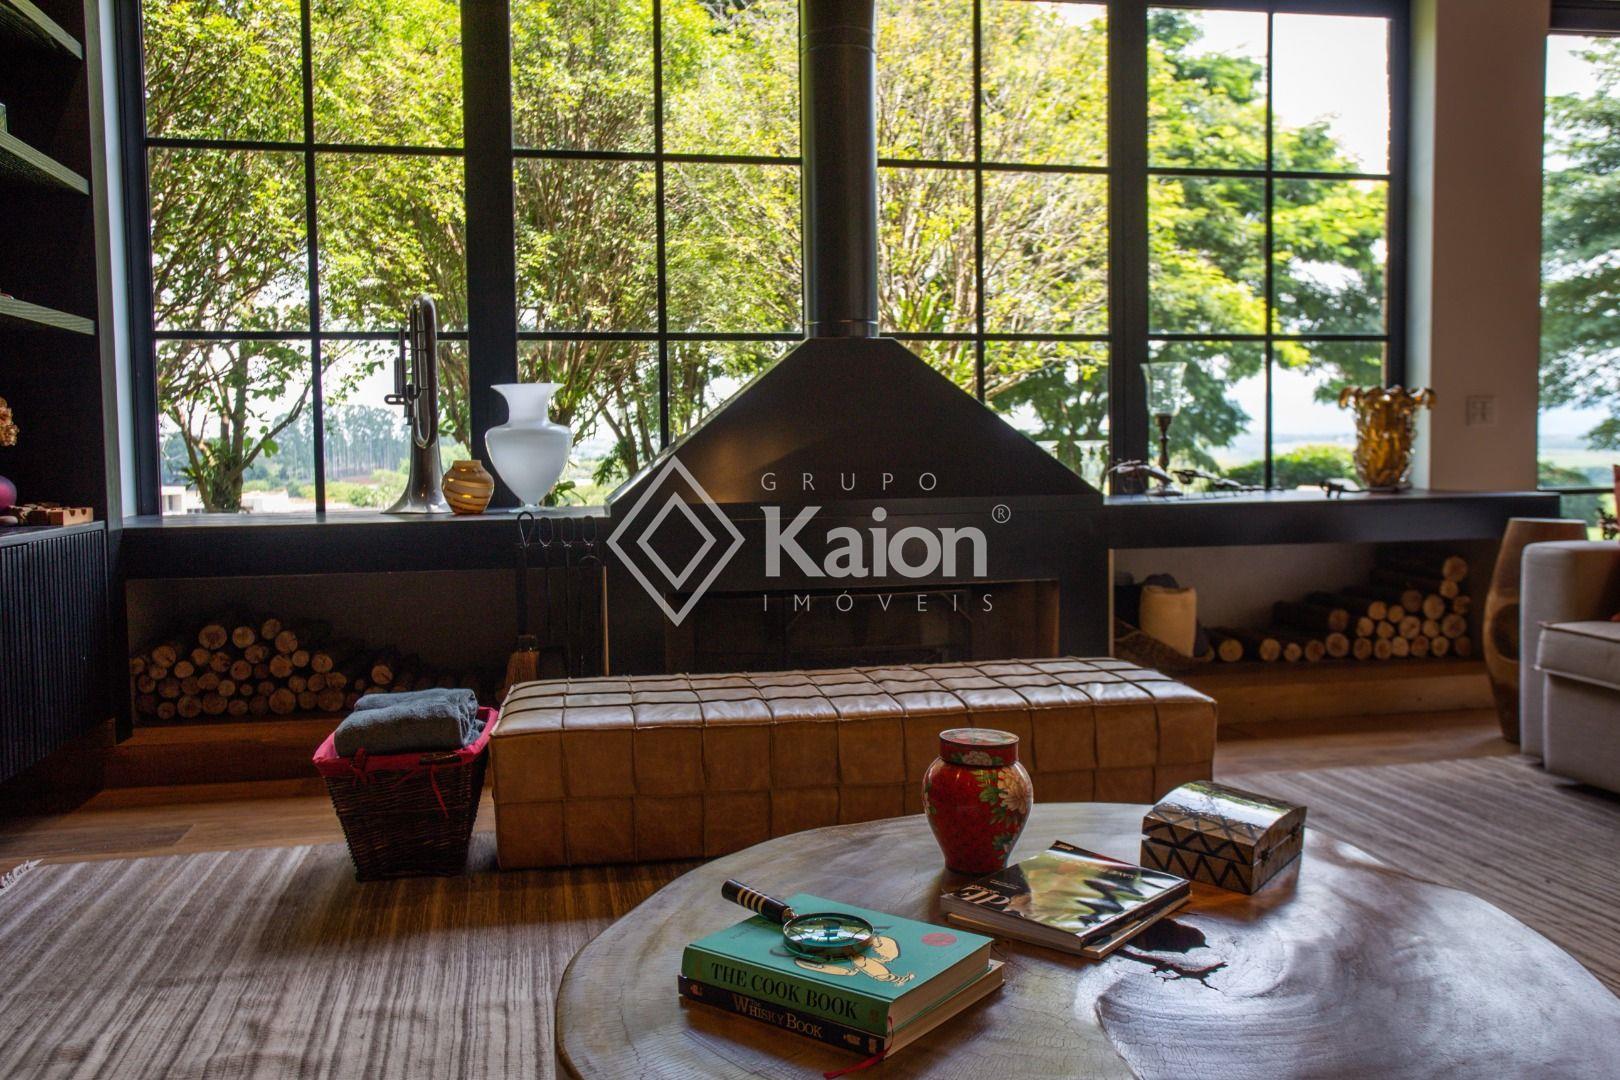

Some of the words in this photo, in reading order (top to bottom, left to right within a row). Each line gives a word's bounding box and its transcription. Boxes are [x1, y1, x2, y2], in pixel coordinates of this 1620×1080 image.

[711, 963, 747, 987] THE
[751, 974, 799, 1003] COOK
[806, 988, 857, 1019] BOOK
